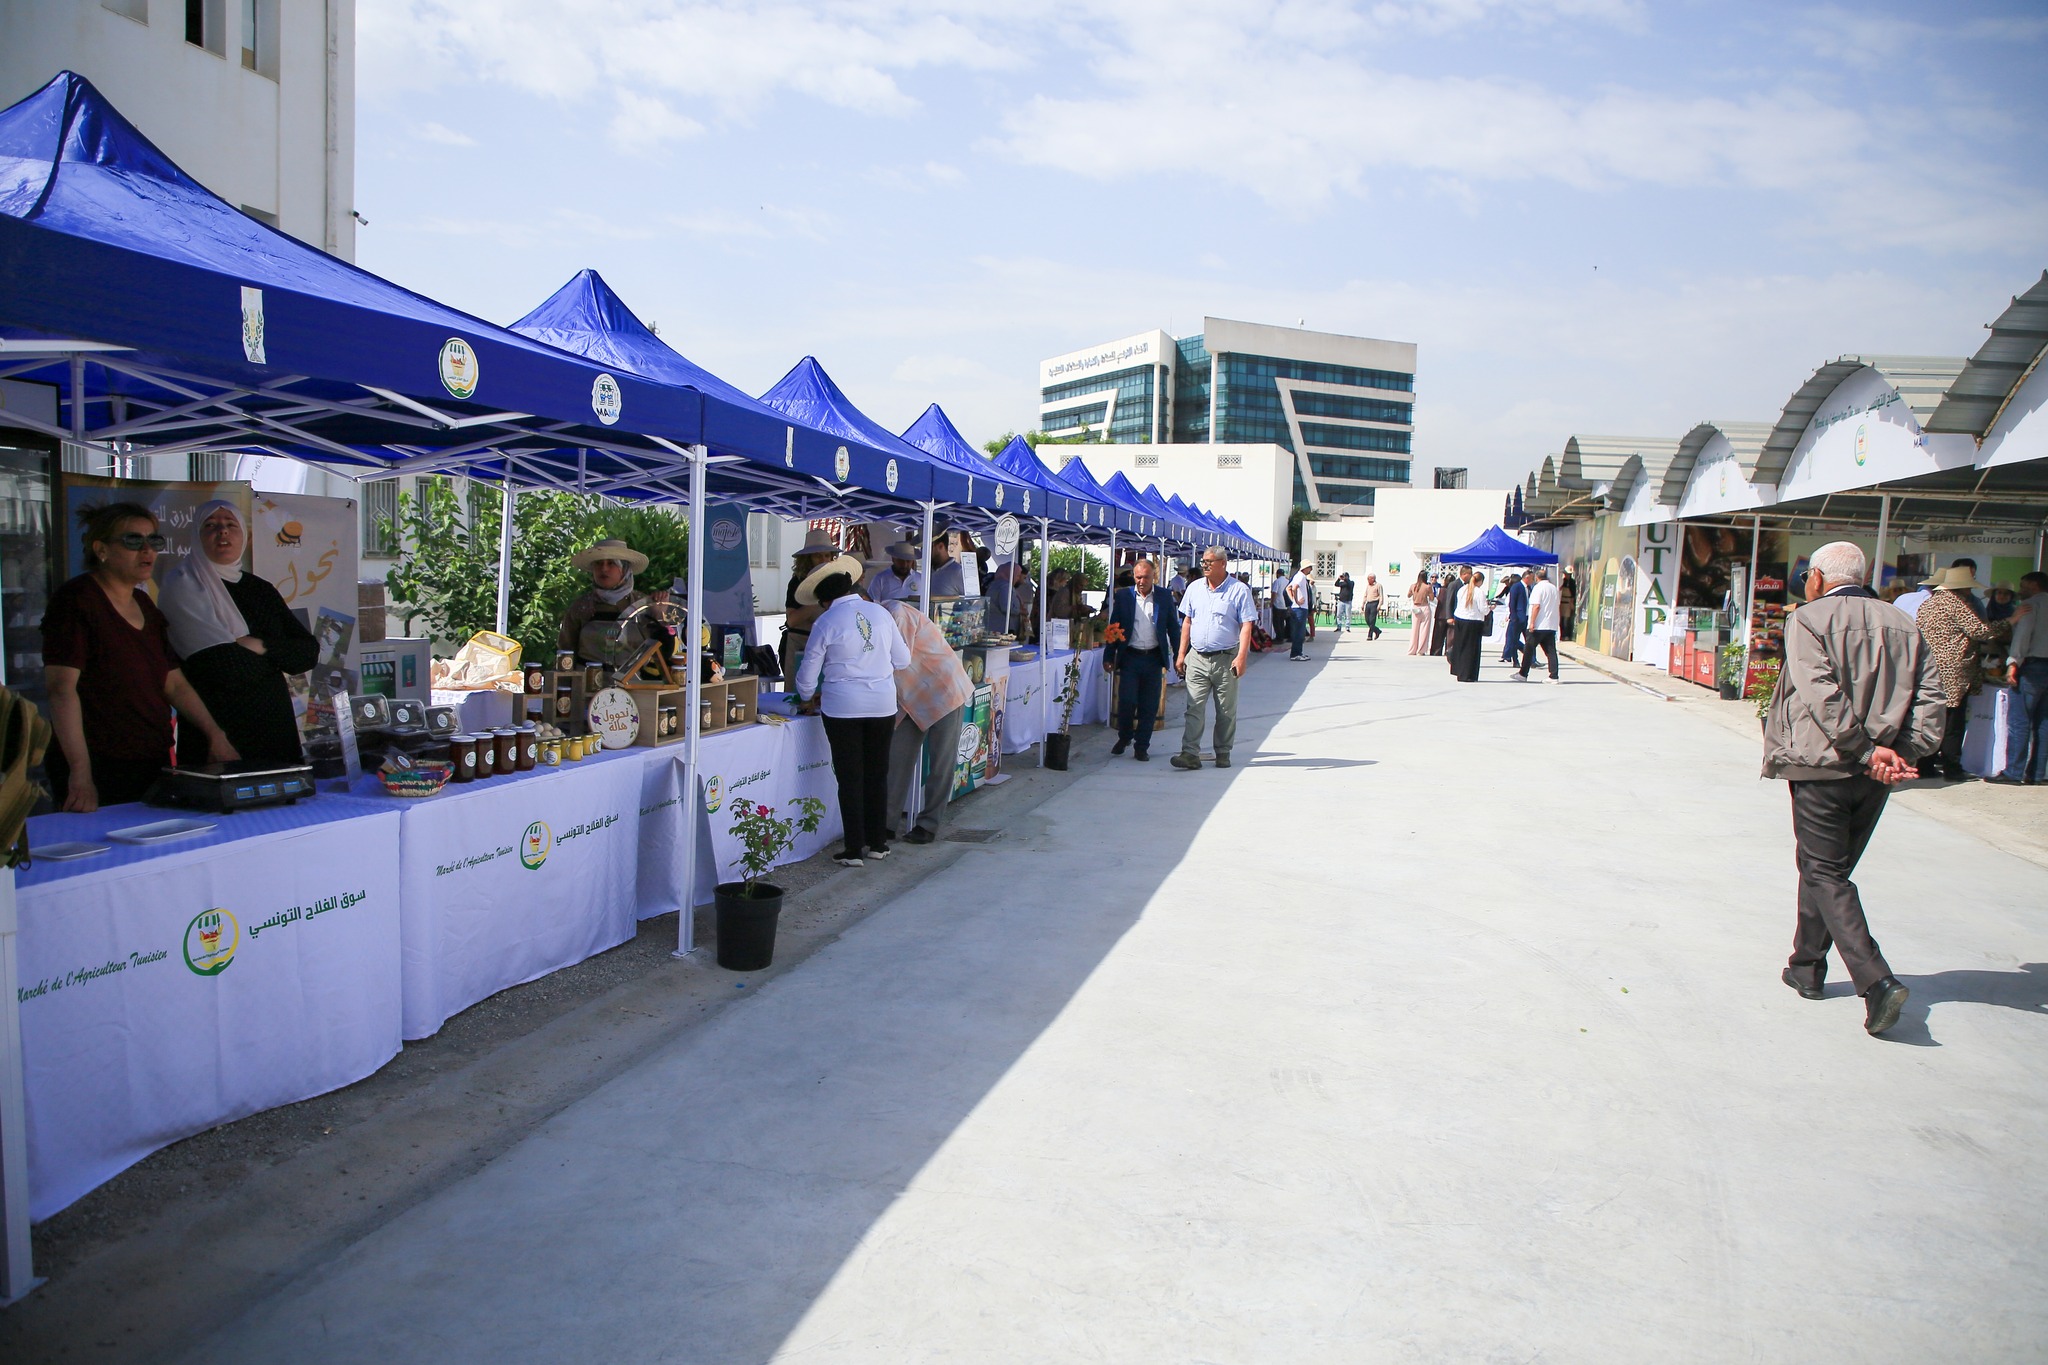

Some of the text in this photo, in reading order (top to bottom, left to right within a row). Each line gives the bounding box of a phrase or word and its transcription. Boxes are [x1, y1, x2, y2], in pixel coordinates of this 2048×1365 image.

[1962, 534, 2031, 545] Assurances
[249, 889, 366, 939] سوق الفلاح التونسي
[51, 974, 64, 992] de
[66, 961, 127, 987] l'Agriculteur
[130, 949, 168, 970] Tunisien
